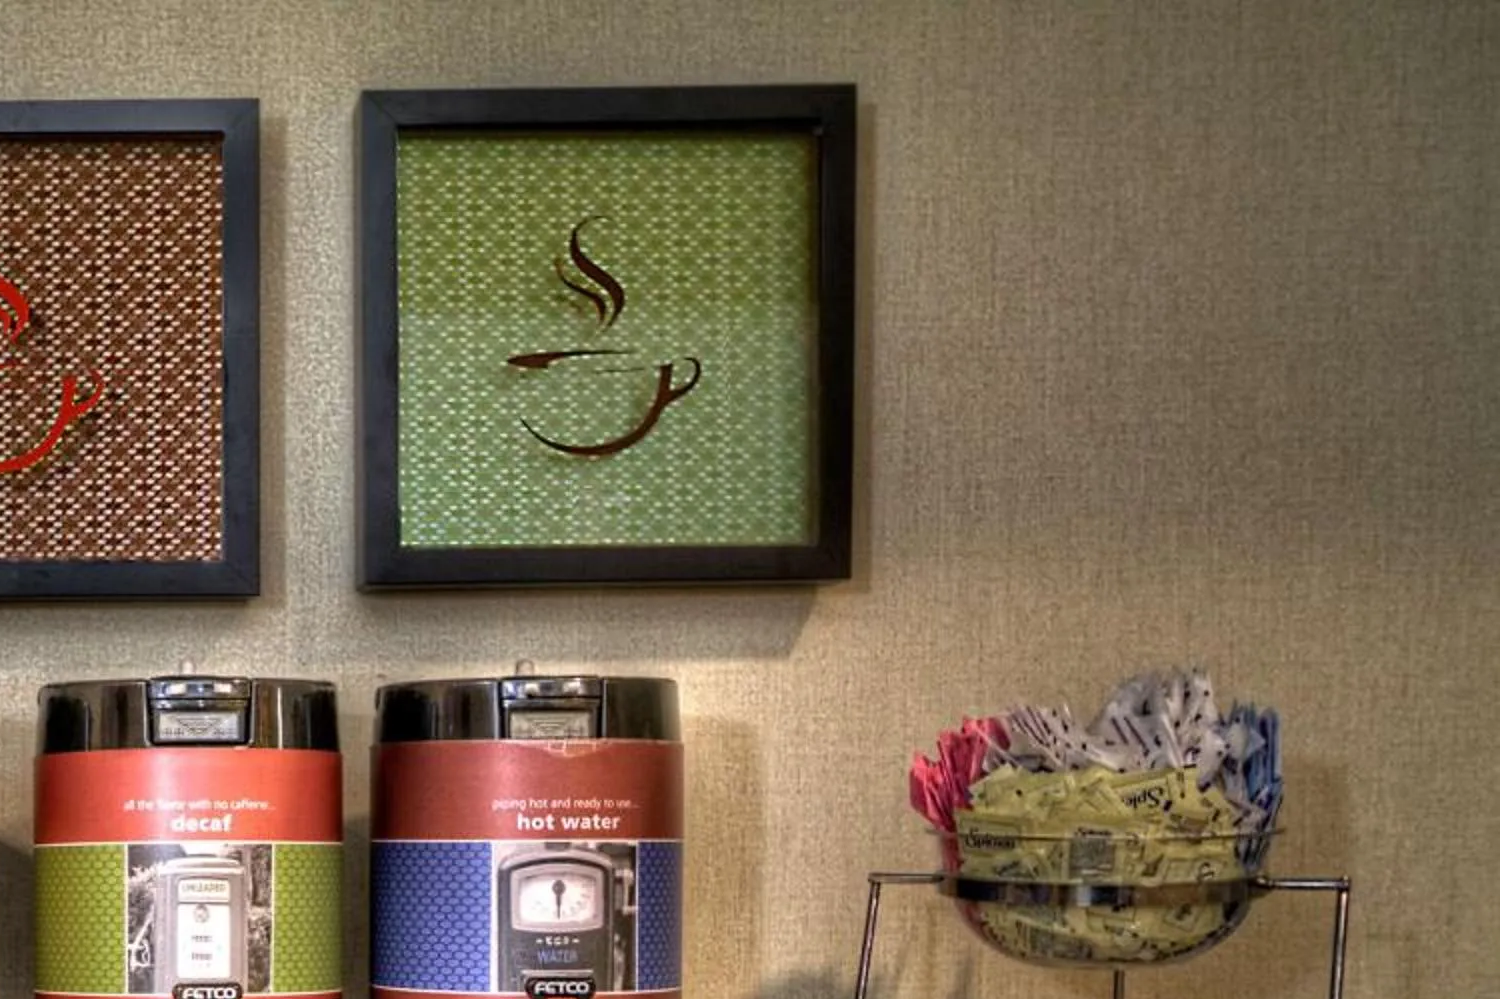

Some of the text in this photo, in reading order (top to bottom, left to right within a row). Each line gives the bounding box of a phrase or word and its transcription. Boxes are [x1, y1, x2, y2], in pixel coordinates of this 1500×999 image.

[214, 800, 229, 810] no
[529, 797, 548, 809] hot
[550, 797, 571, 809] and
[573, 798, 602, 811] ready
[603, 799, 614, 809] to
[170, 813, 233, 832] decaf
[516, 812, 621, 830] hot water
[181, 986, 238, 999] FETCO
[534, 981, 590, 995] FETCO
